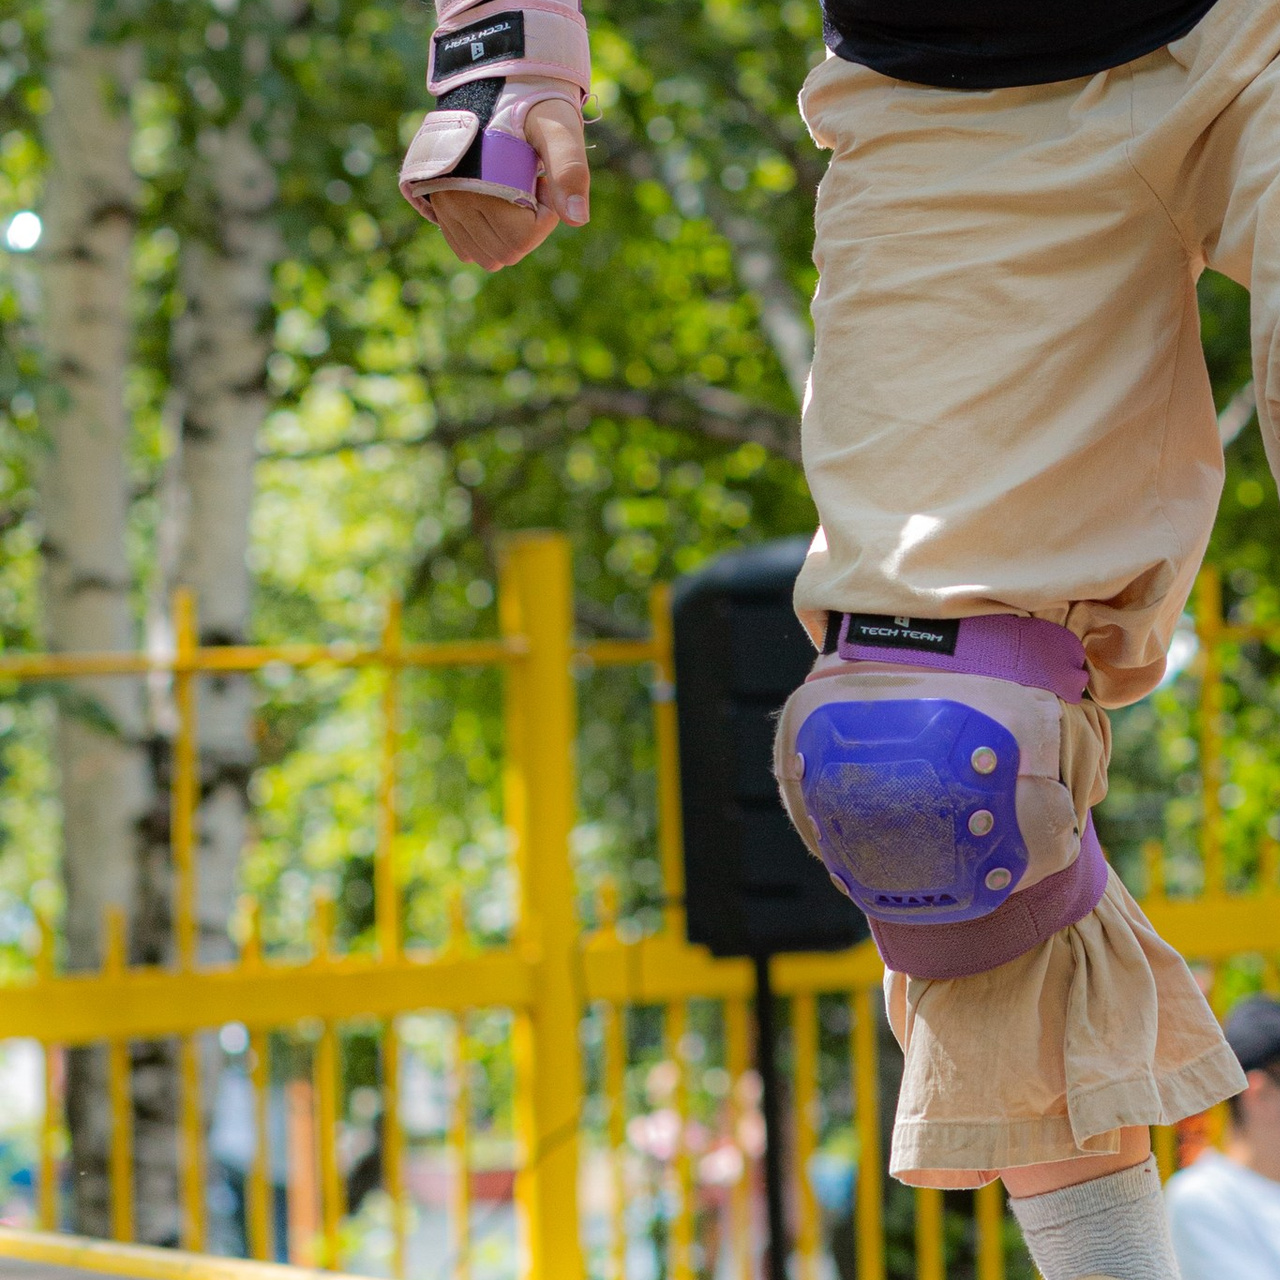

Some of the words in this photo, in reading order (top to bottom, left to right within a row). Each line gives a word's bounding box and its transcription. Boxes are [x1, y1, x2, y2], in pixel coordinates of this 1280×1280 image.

[478, 22, 511, 39] TECH
[444, 34, 477, 51] TEAM
[860, 626, 899, 637] TECH
[901, 629, 943, 642] TEAM
